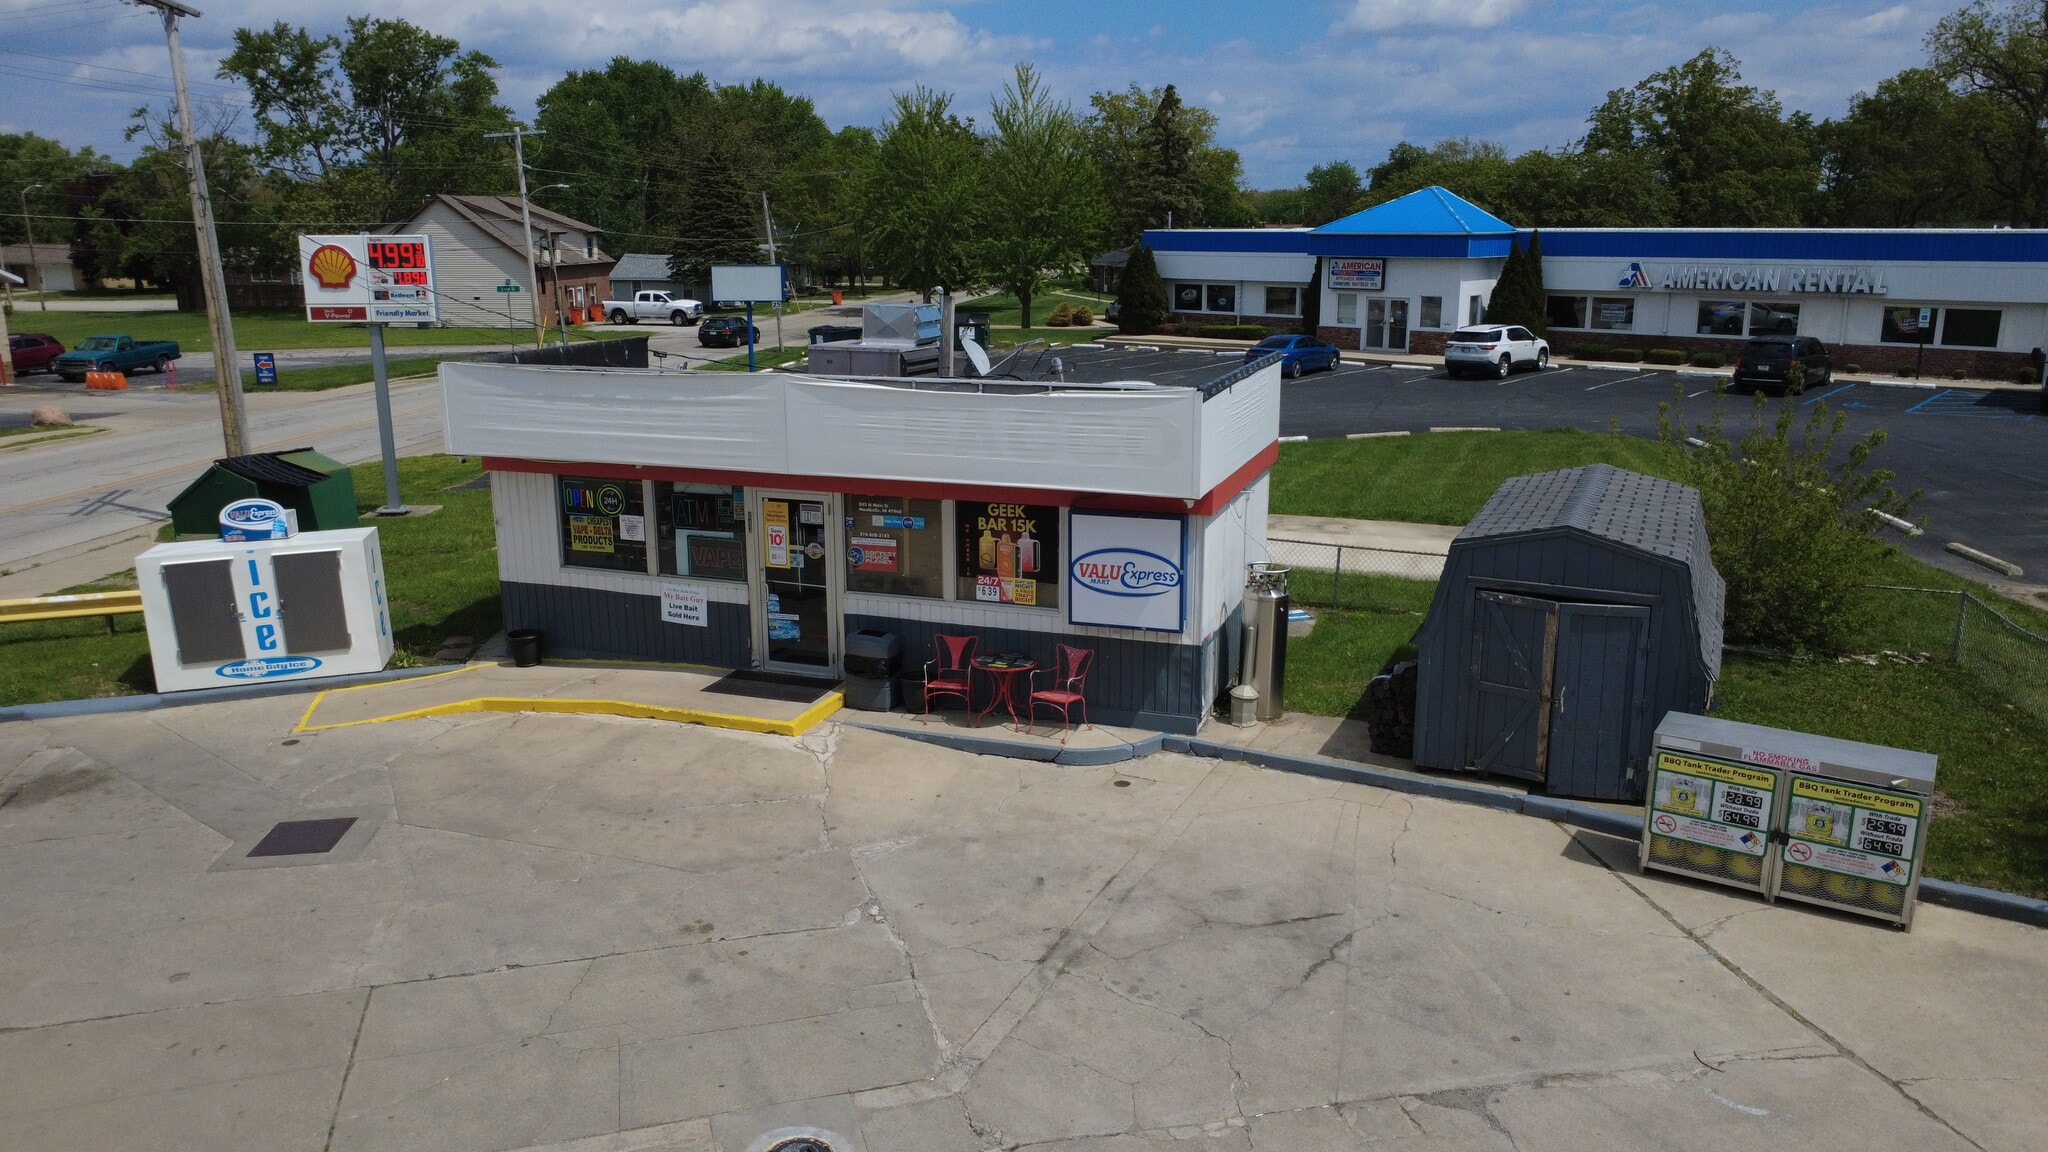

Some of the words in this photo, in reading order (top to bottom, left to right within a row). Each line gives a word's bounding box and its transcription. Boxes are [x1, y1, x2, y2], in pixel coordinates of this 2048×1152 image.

[368, 243, 414, 268] 4.99
[1341, 262, 1382, 270] AMERICAN
[1661, 266, 1781, 292] AMERICAN
[1788, 268, 1887, 294] RENTAL
[376, 310, 403, 318] Friendly
[566, 488, 594, 508] OPEN
[603, 496, 618, 505] 24H
[250, 508, 278, 520] Express
[676, 500, 708, 526] ATM
[988, 504, 1026, 518] GEEK
[586, 517, 612, 526] CHEAPEST
[978, 517, 1007, 531] BAR
[1011, 520, 1037, 533] 15K
[573, 525, 588, 534] VAPE
[593, 526, 612, 536] DELTA
[573, 535, 613, 545] PRODUCTS
[692, 546, 741, 570] VAPE
[978, 576, 998, 585] 24/7
[1079, 563, 1121, 580] VALU
[1120, 562, 1176, 587] Express
[675, 594, 688, 602] Bait
[690, 596, 704, 605] Guy
[669, 602, 683, 611] Live
[684, 604, 698, 612] Bait
[668, 610, 682, 619] Sold
[683, 613, 700, 621] Here
[231, 665, 264, 673] Home
[1744, 754, 1796, 768] FLAMMABLE
[1799, 764, 1818, 772] GAS
[1768, 753, 1809, 765] SMOKING
[1664, 757, 1682, 766] BBQ
[1683, 761, 1702, 770] Tank
[1704, 764, 1731, 775] Trader
[1732, 770, 1769, 782] Program
[1742, 787, 1758, 795] Trade
[1799, 782, 1818, 792] BBQ
[1820, 787, 1841, 796] Tank
[1844, 790, 1873, 800] Trader
[1874, 796, 1914, 809] Program
[1720, 803, 1742, 812] Without
[1743, 807, 1759, 816] Trade
[1724, 811, 1759, 826] 64.99
[1884, 814, 1901, 822] Trade
[1867, 819, 1906, 836] 25.99
[1860, 830, 1884, 840] Without
[1885, 835, 1903, 843] Trade
[1864, 839, 1902, 856] 64.99
